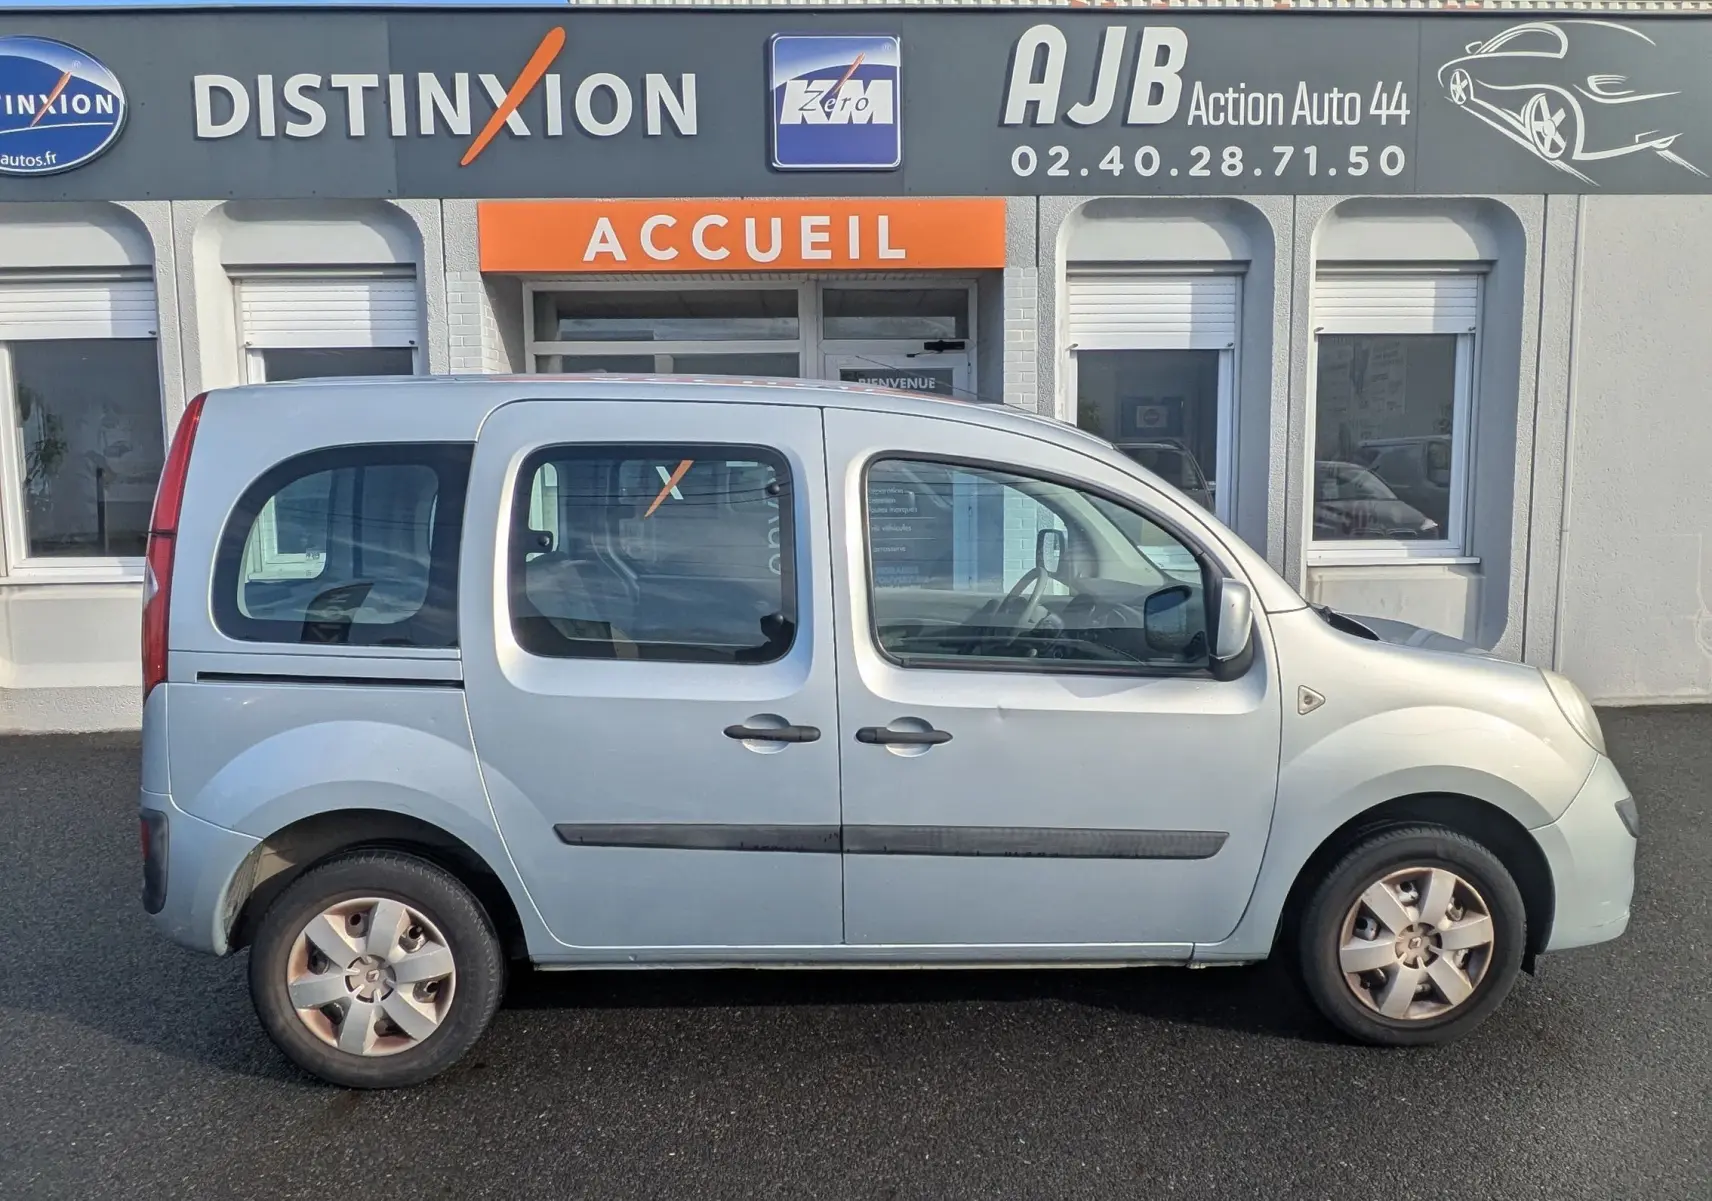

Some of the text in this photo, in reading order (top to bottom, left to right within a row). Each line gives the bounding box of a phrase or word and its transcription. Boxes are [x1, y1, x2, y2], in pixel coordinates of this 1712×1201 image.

[1004, 24, 1411, 126] AJB Action Auto 44
[780, 79, 893, 124] KM
[798, 89, 870, 113] Zero
[1012, 146, 1405, 177] 02.40.28.71.50
[583, 214, 906, 262] ACCUEIL
